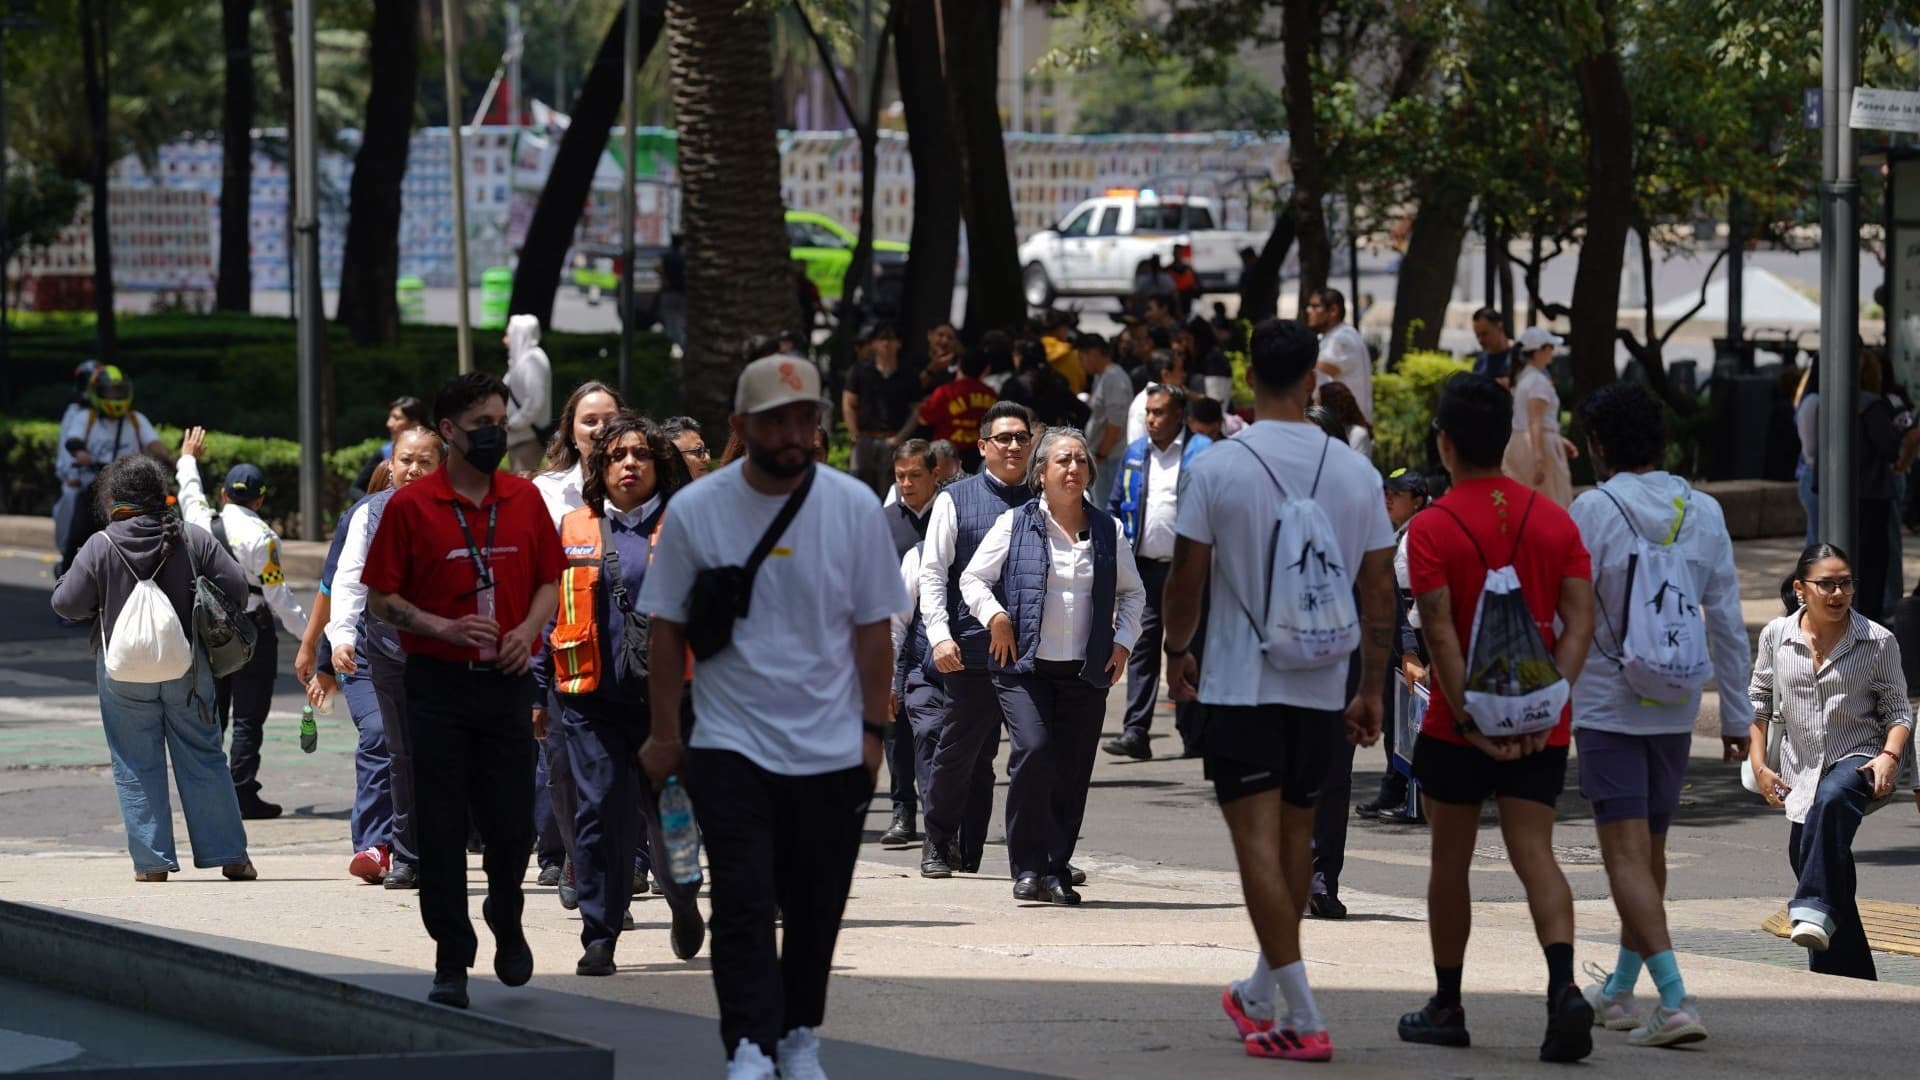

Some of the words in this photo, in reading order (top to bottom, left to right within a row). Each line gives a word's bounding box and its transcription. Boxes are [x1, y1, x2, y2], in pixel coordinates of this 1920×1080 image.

[1857, 101, 1885, 111] Paseo
[1888, 103, 1900, 112] de
[1903, 103, 1912, 113] la
